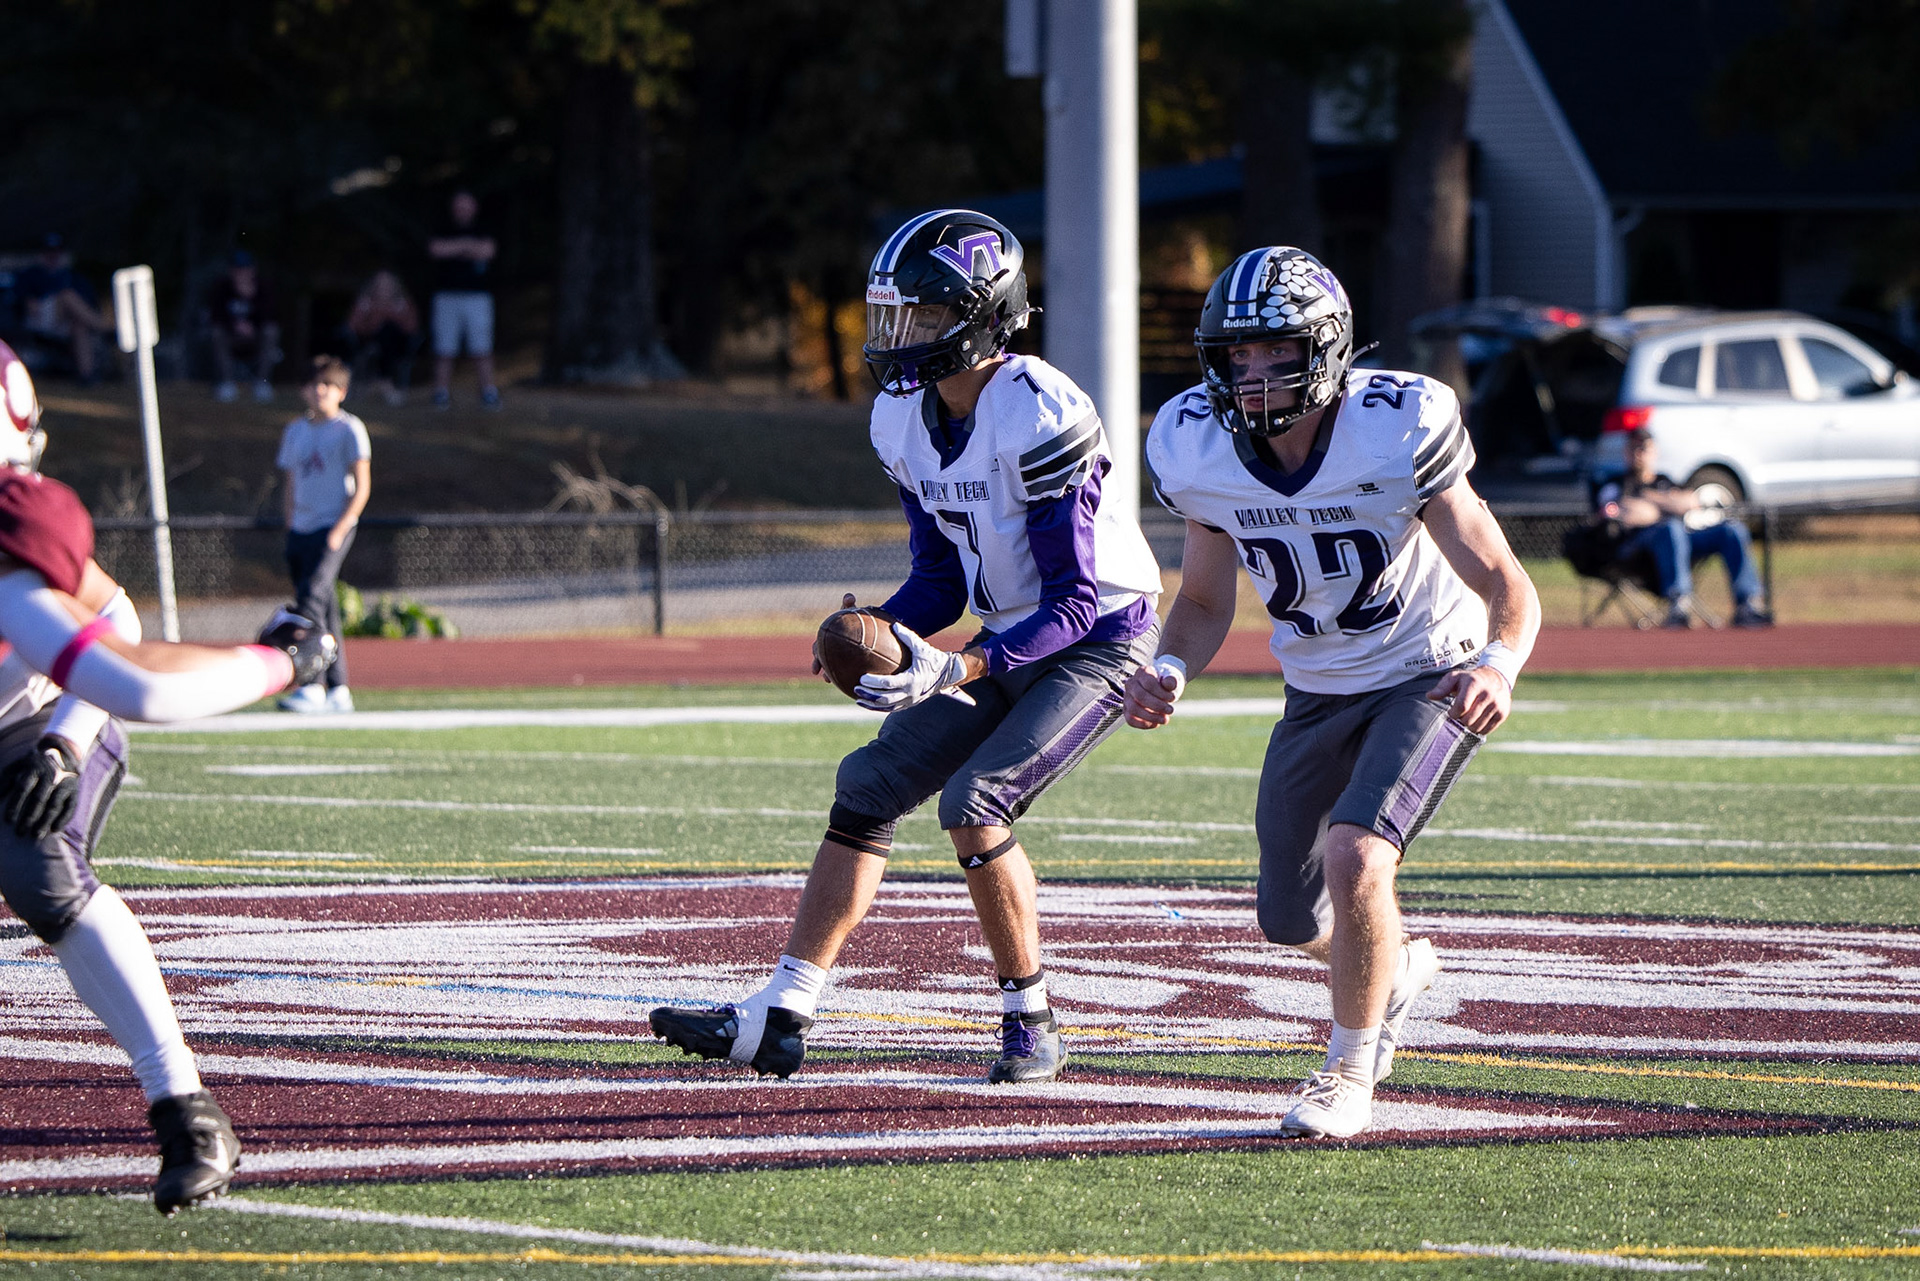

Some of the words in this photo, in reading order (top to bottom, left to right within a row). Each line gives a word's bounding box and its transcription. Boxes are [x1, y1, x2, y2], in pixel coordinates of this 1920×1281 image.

[929, 231, 1002, 285] VT
[868, 290, 895, 301] Riddell
[1222, 317, 1260, 328] Riddell
[1012, 372, 1045, 394] 7
[1362, 374, 1415, 410] 22
[954, 480, 990, 502] TECH
[1234, 507, 1299, 529] VALLEY
[1305, 505, 1356, 526] TECH
[936, 509, 999, 614] 7
[1235, 529, 1404, 638] 22
